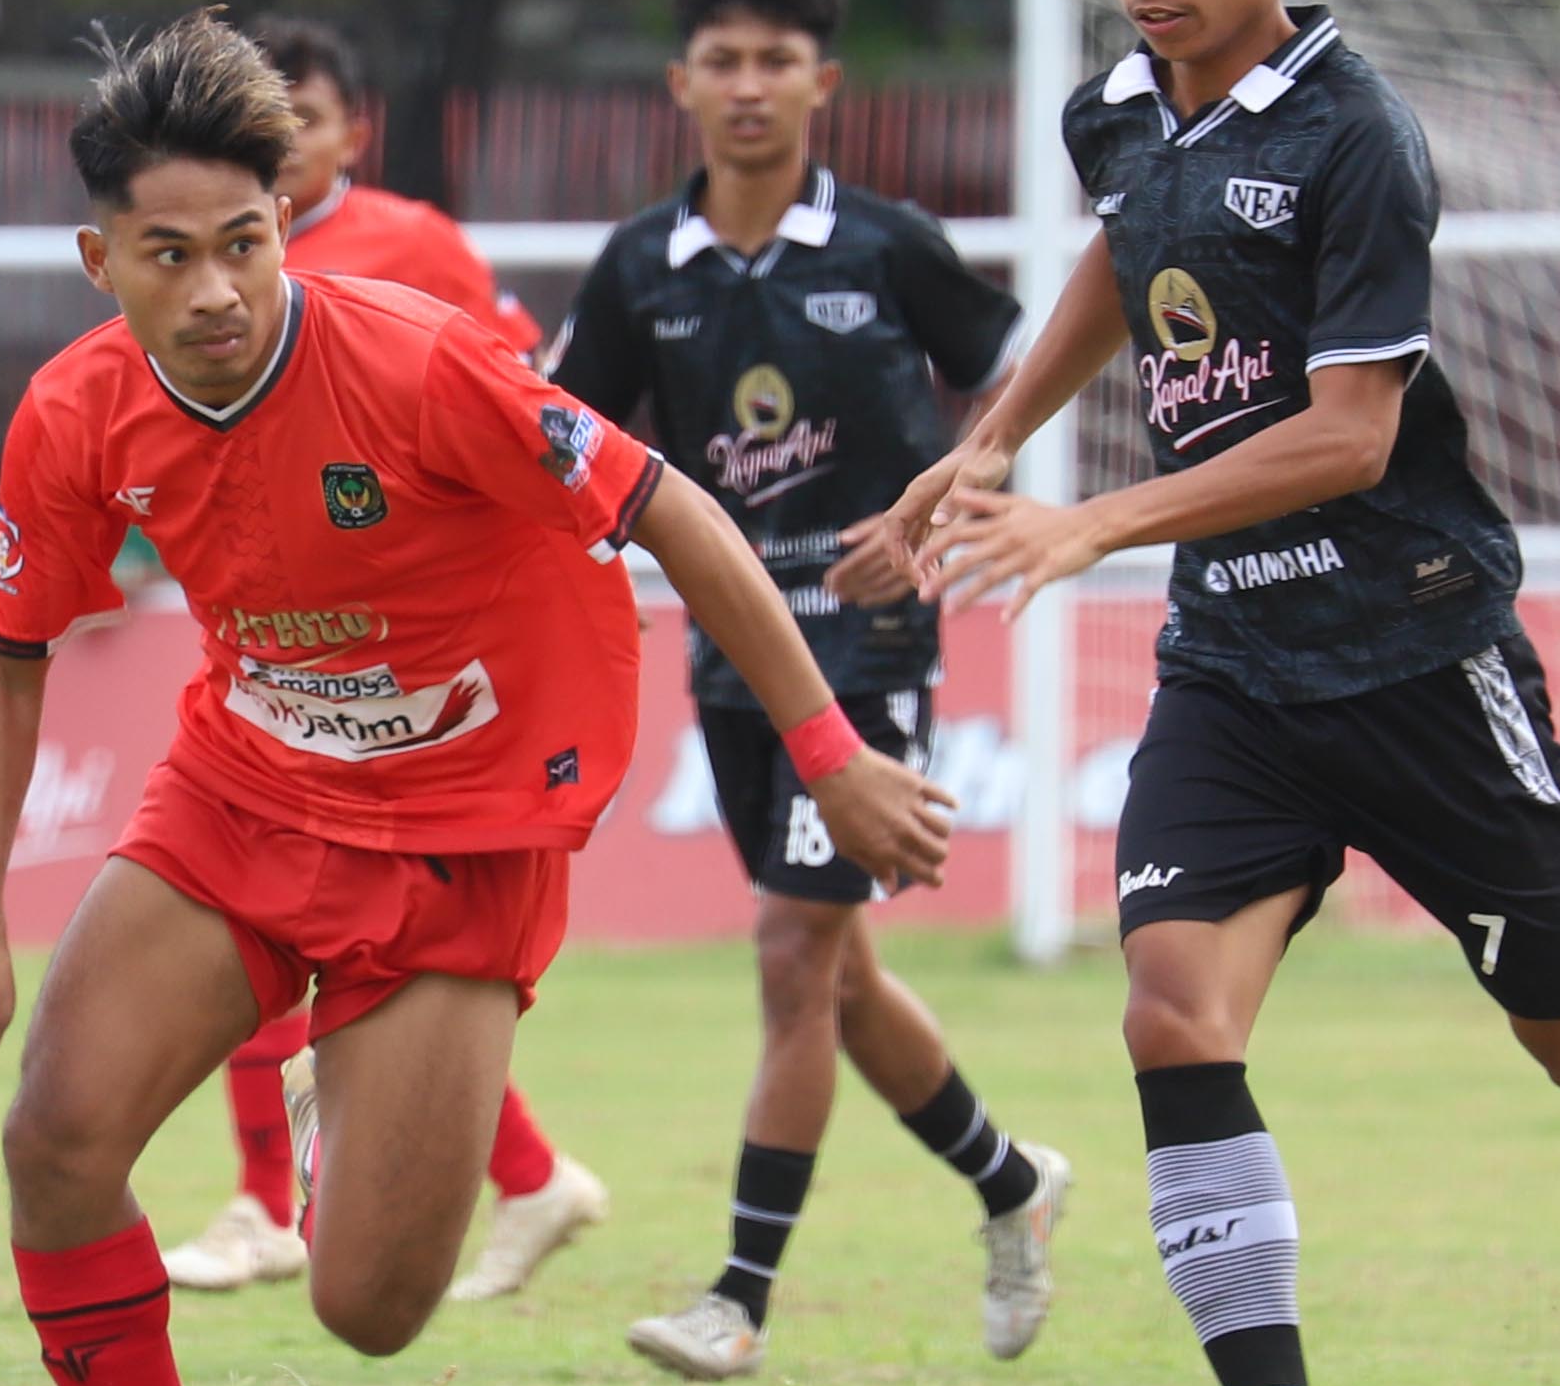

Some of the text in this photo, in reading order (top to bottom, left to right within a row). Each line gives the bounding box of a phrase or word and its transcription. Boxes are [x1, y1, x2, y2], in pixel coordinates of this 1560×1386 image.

[1231, 183, 1297, 221] NEA
[1139, 338, 1274, 433] Kapal Api
[1226, 537, 1345, 591] YAMAHA
[1467, 912, 1507, 976] 7
